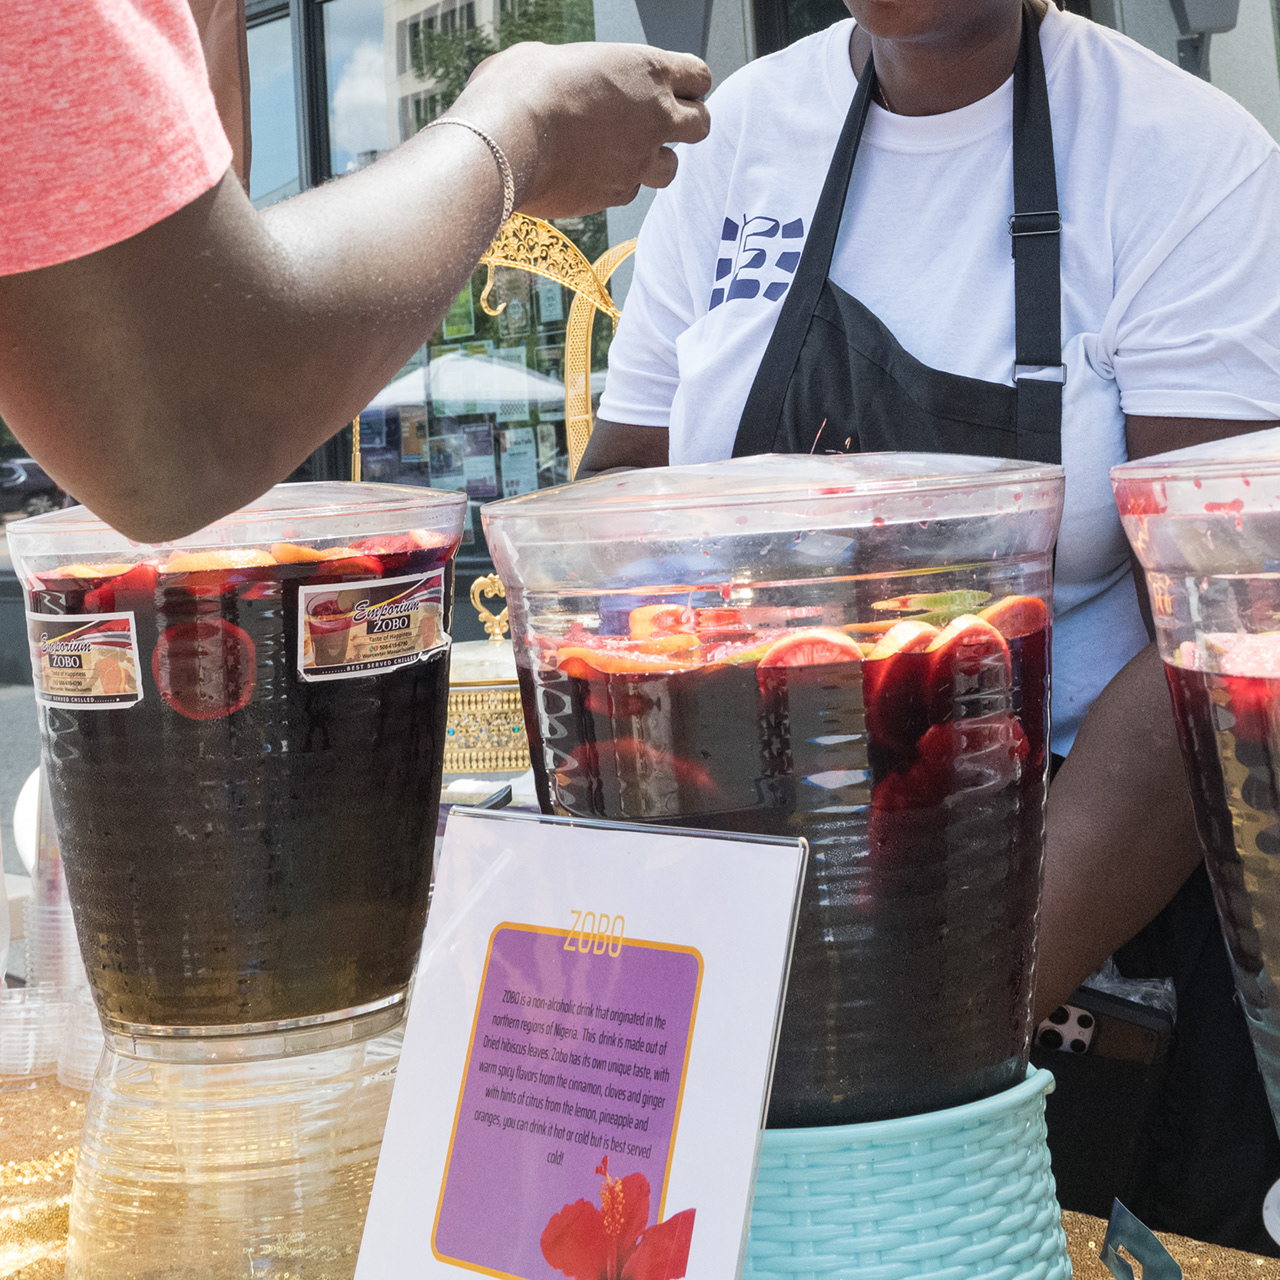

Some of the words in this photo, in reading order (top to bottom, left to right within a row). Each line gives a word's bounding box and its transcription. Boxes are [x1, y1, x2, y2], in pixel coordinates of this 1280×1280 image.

[352, 599, 420, 623] Emporium
[373, 617, 408, 633] ZOBO
[41, 632, 92, 654] Emporium
[390, 631, 412, 641] Happiness
[52, 656, 79, 668] ZOBO
[367, 660, 392, 669] SERVED
[564, 909, 625, 958] ZOBO
[502, 990, 520, 1004] ZOBO
[532, 998, 576, 1013] non-alcoholic
[577, 1002, 593, 1016] drink
[595, 1005, 609, 1019] that
[609, 1009, 645, 1026] originated
[654, 1014, 666, 1030] the
[492, 1014, 520, 1028] northern
[521, 1020, 544, 1034] regions
[553, 1022, 578, 1040] Nigeria.
[582, 1028, 596, 1043] This
[598, 1031, 616, 1046] drink
[624, 1037, 644, 1052] made
[645, 1041, 658, 1054] out
[483, 1035, 500, 1050] Dried
[500, 1038, 526, 1055] hibiscus
[527, 1043, 549, 1059] leaves.
[551, 1047, 568, 1063] Zobo
[569, 1051, 581, 1066] has
[592, 1058, 607, 1070] own
[608, 1060, 631, 1076] unique
[632, 1064, 652, 1080] taste,
[653, 1067, 670, 1082] with
[479, 1062, 497, 1073] warm
[498, 1065, 515, 1081] spicy
[516, 1065, 538, 1082] flavors
[539, 1070, 555, 1085] from
[556, 1074, 568, 1088] the
[569, 1079, 603, 1096] cinnamon,
[604, 1084, 626, 1100] cloves
[627, 1090, 642, 1103] and
[642, 1092, 666, 1110] ginger
[485, 1085, 500, 1098] with
[500, 1088, 516, 1103] hints
[525, 1093, 544, 1109] citrus
[545, 1096, 561, 1112] from
[562, 1100, 574, 1115] the
[574, 1103, 597, 1121] lemon,
[599, 1109, 634, 1129] pineapple
[634, 1117, 649, 1131] and
[474, 1110, 501, 1127] oranges,
[502, 1117, 515, 1130] you
[516, 1119, 529, 1131] can
[529, 1120, 547, 1135] drink
[553, 1123, 566, 1139] hot
[574, 1130, 589, 1145] cold
[590, 1132, 602, 1147] but
[610, 1136, 626, 1153] best
[627, 1144, 652, 1159] served
[547, 1150, 564, 1165] cold!
